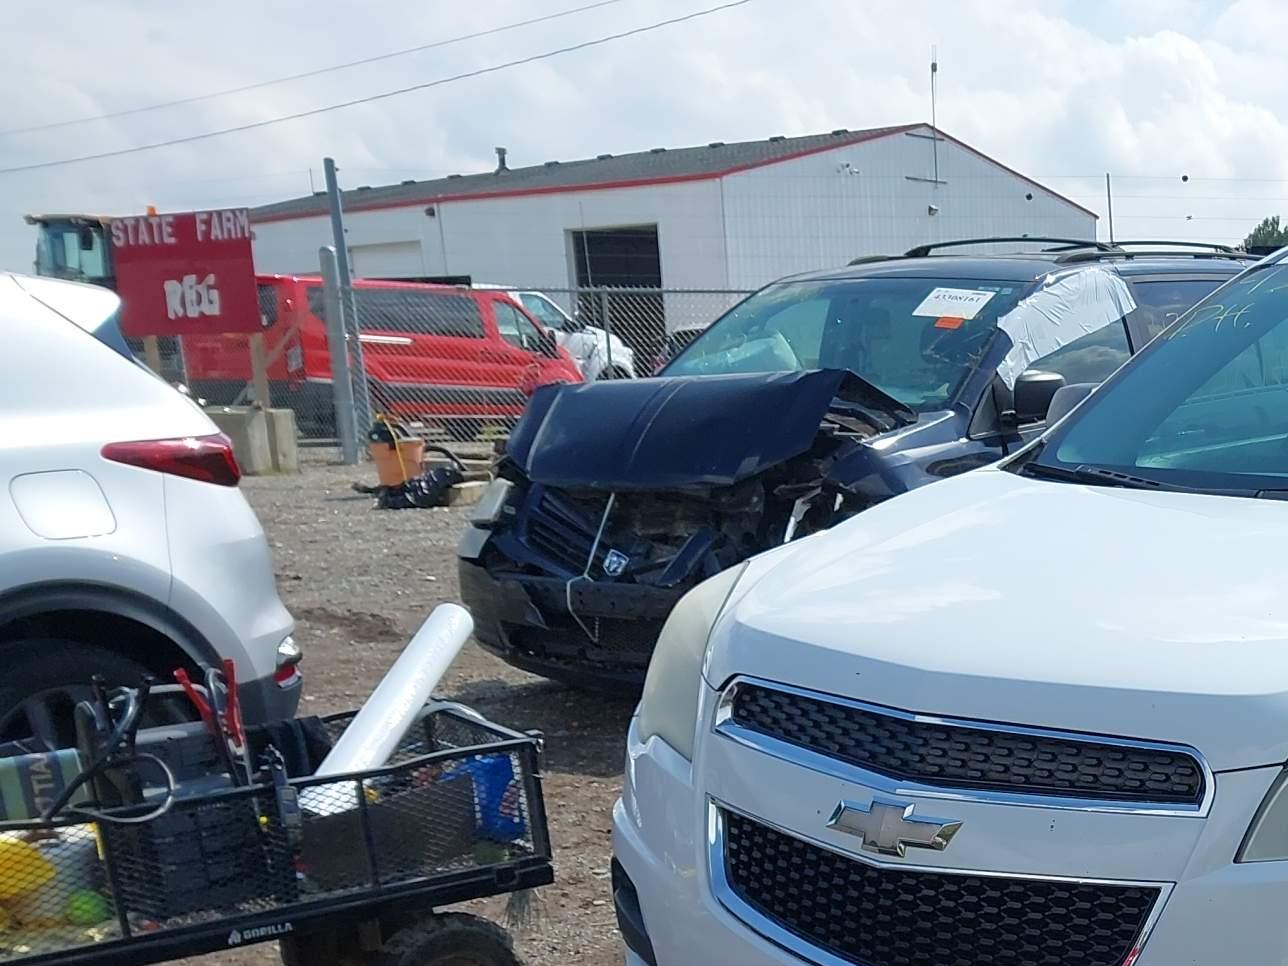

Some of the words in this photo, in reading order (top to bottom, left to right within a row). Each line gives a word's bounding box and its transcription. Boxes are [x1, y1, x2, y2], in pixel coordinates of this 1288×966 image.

[111, 216, 177, 247] STATE
[195, 209, 249, 240] FARM
[243, 922, 293, 939] GORILLA
